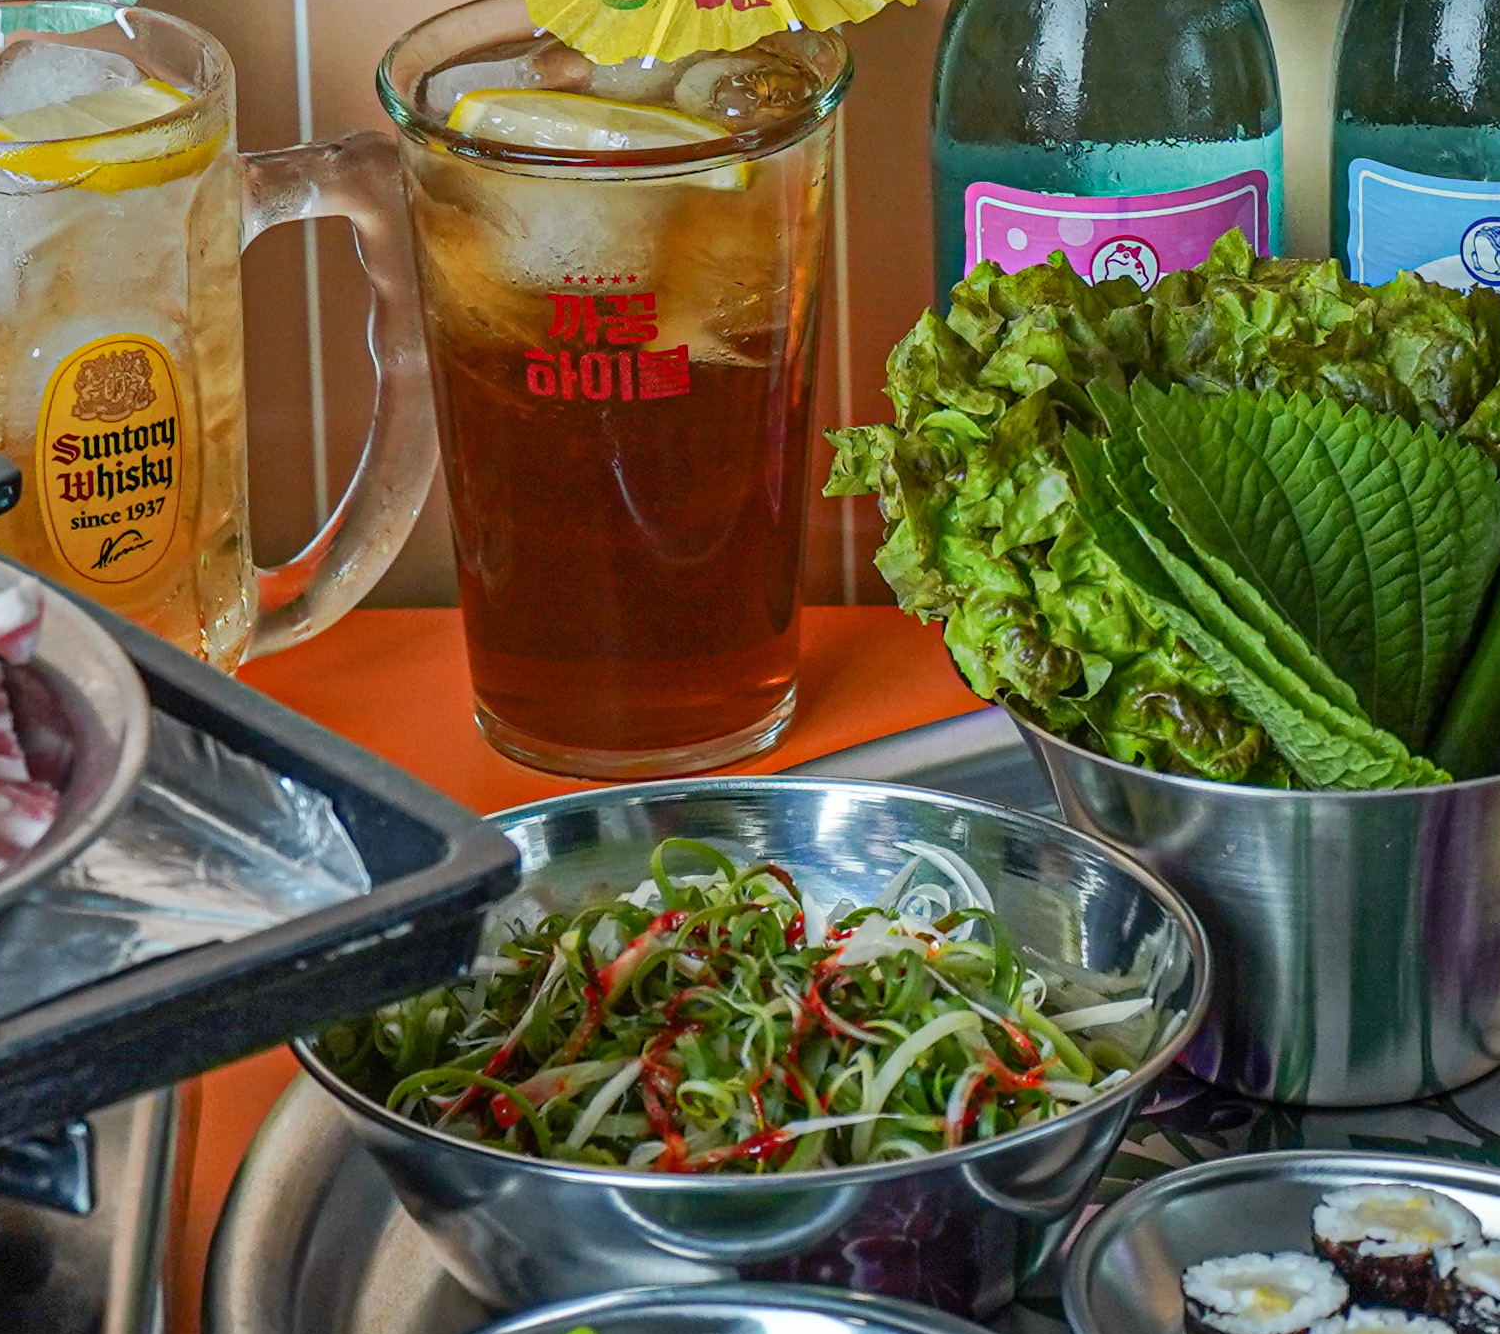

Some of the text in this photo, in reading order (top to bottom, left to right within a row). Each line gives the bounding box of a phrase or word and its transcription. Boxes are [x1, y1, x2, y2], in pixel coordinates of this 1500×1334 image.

[547, 292, 658, 345] 까꿍
[524, 344, 690, 401] 하이볼
[52, 416, 175, 466] Suntory
[56, 453, 173, 502] Whisky
[71, 497, 166, 530] since 1937
